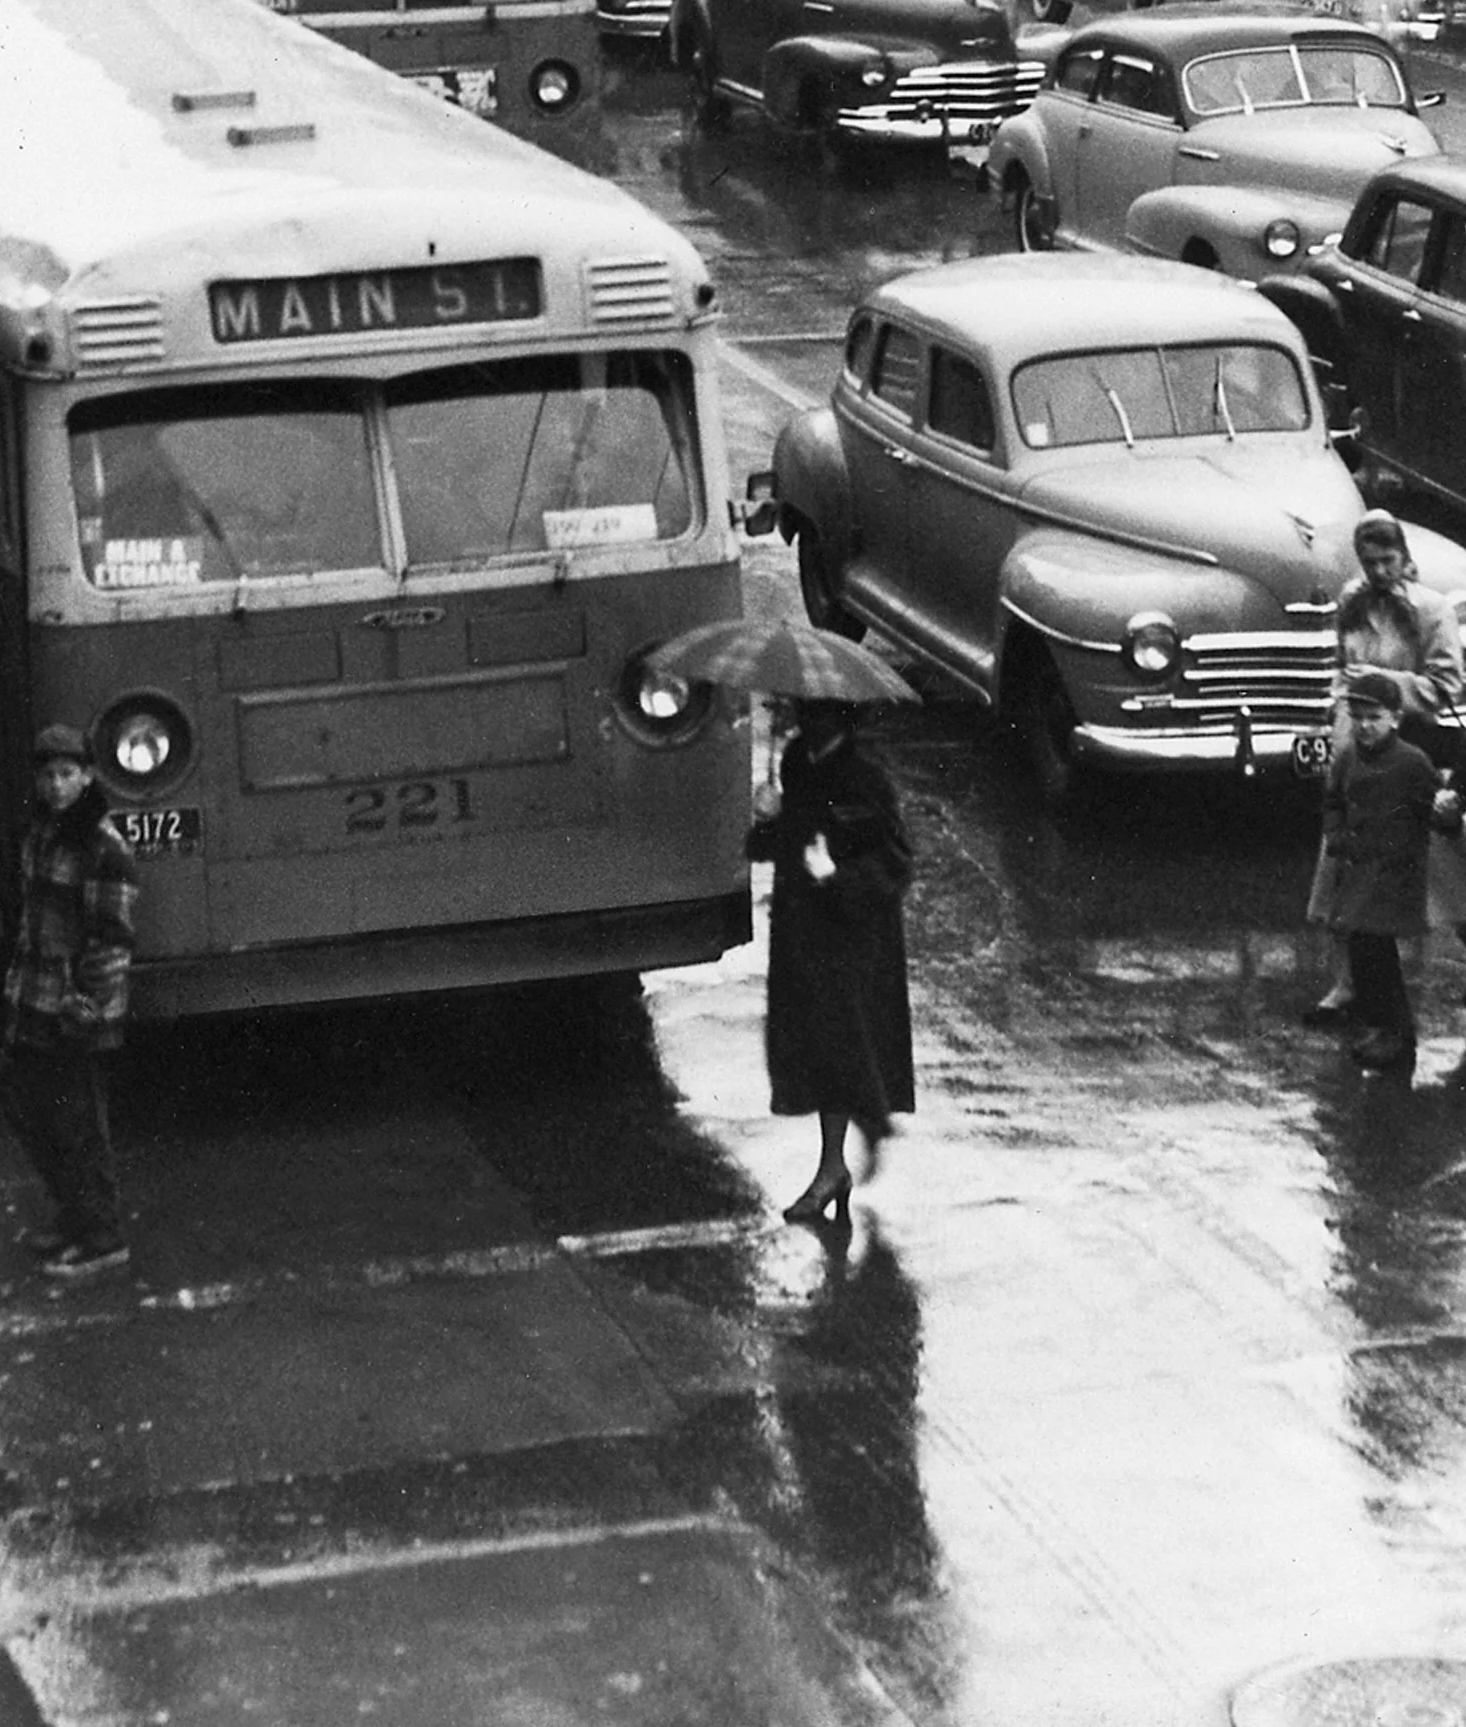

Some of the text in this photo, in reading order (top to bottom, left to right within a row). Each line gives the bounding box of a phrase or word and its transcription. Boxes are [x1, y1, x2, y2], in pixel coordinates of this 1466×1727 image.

[216, 276, 397, 338] MAIN
[125, 811, 182, 842] 5172
[342, 778, 477, 835] 221
